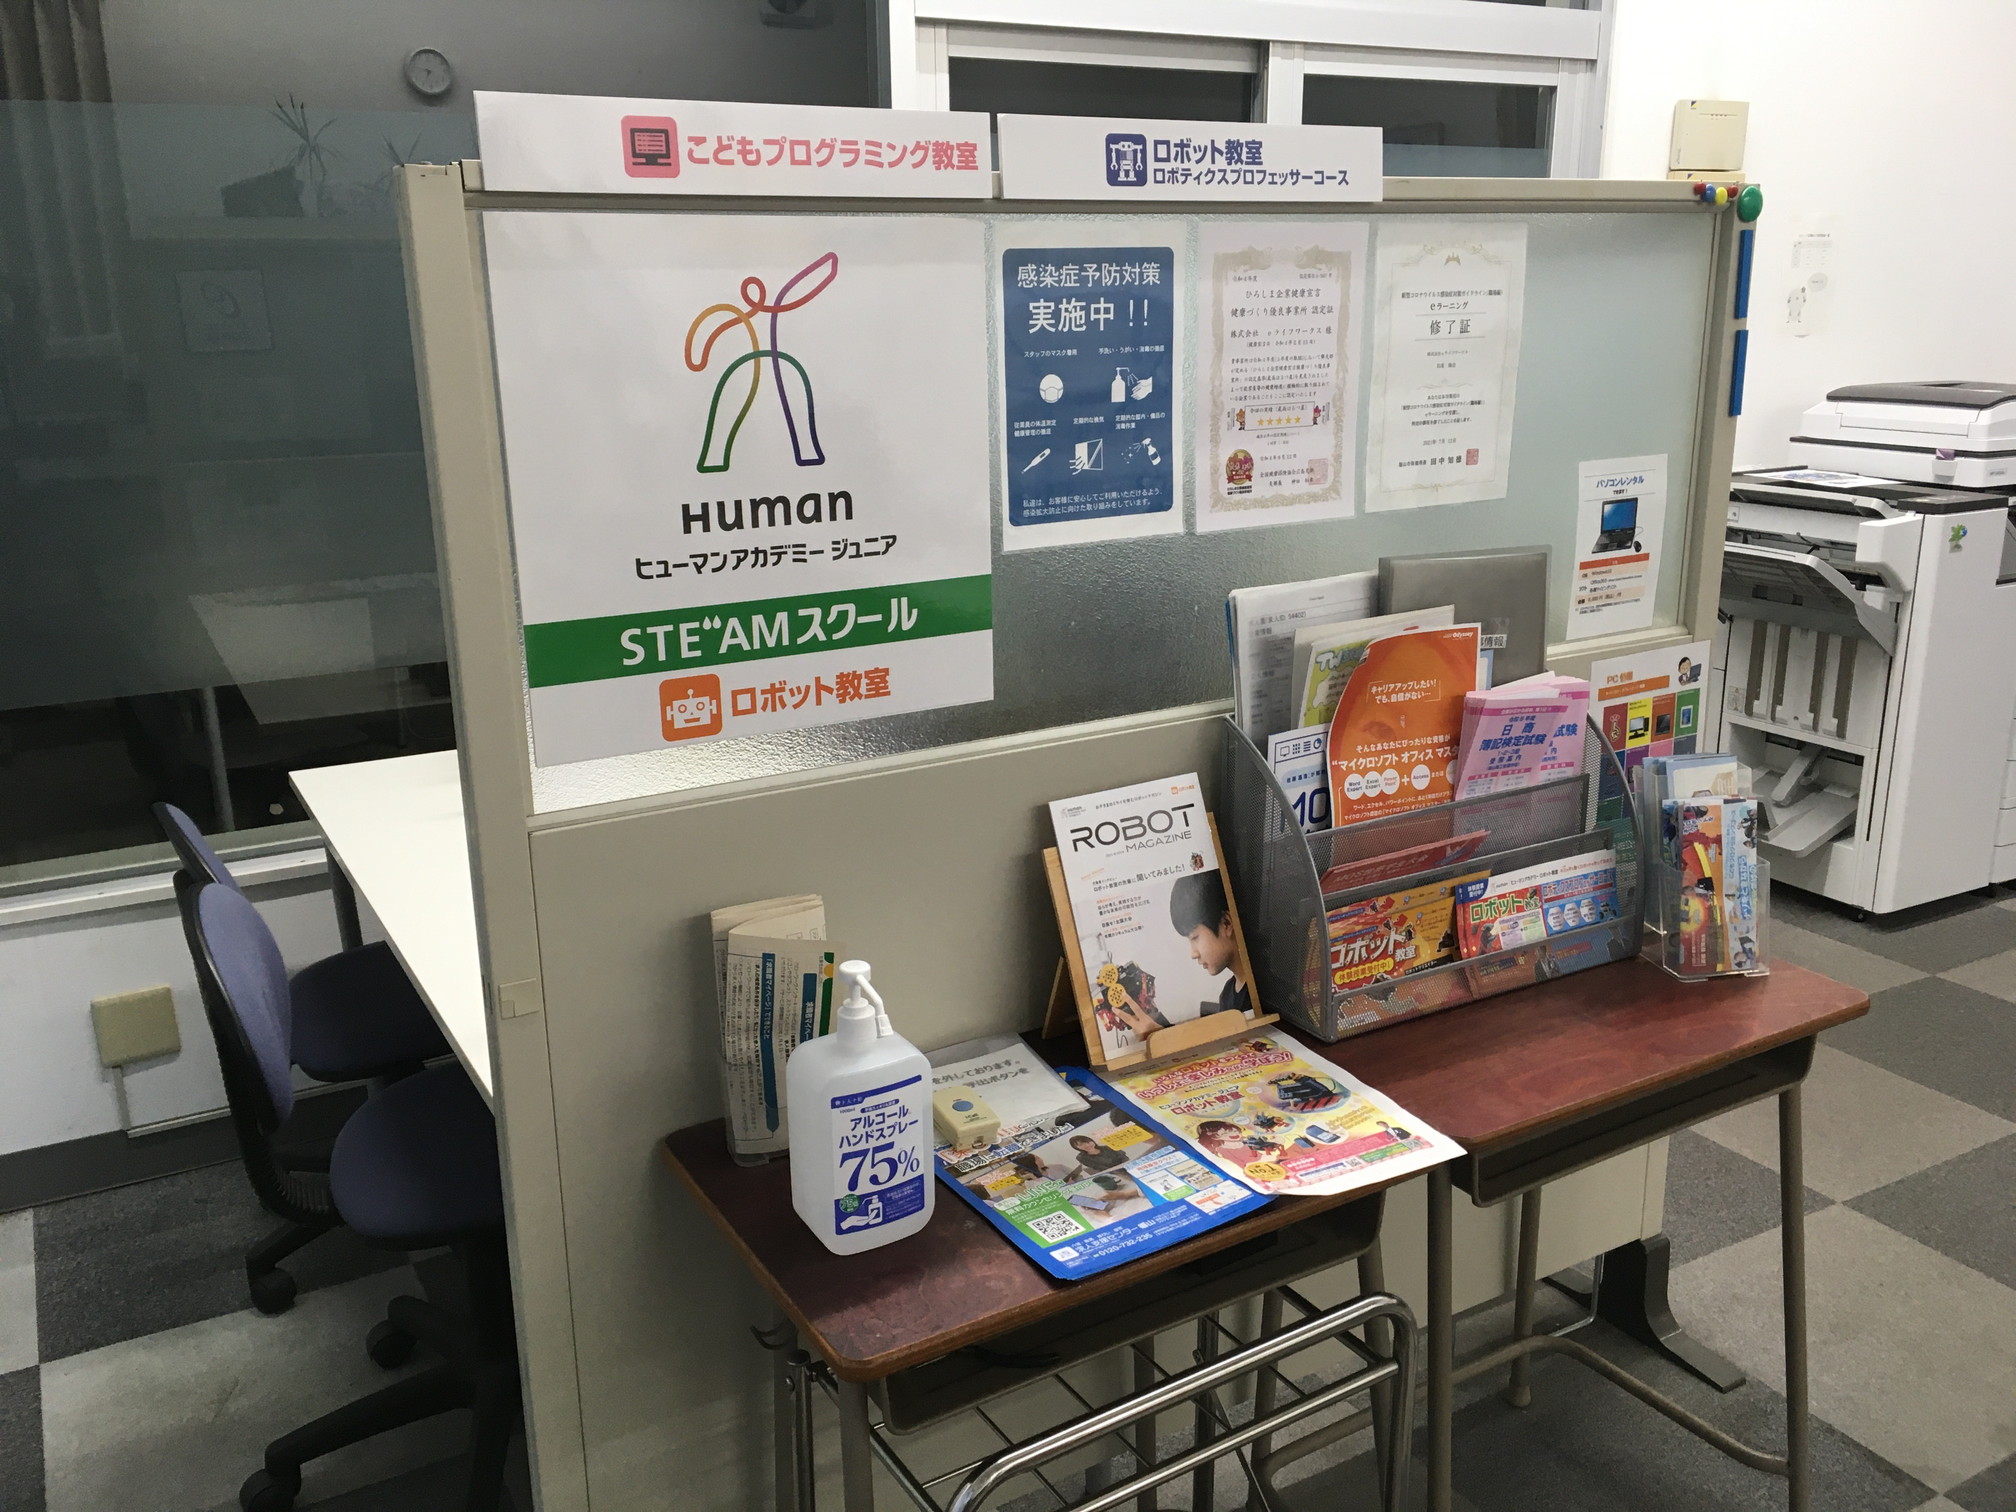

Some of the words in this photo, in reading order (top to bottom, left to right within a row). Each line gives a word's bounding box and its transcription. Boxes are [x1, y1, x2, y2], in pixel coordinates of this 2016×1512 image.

[687, 134, 979, 172] こどもプログラミング教室
[1153, 138, 1263, 166] ロボット教室
[1153, 168, 1350, 187] ロボティクスプロフェッサーコース
[1017, 262, 1161, 288] 感染症予防対策
[1245, 288, 1321, 299] ひろしま企業健康宣言
[1231, 306, 1308, 318] 健康づくり優良事業所
[1311, 305, 1334, 315] 認定証
[1430, 301, 1469, 311] eラーニング
[1430, 318, 1471, 336] 修了証
[1024, 349, 1078, 358] スタッフのマスク着用
[1596, 475, 1645, 488] パソコンレンタル
[682, 490, 853, 534] Human
[635, 543, 824, 580] ヒューマンアカデミー
[831, 534, 898, 561] ジュニア
[731, 667, 891, 717] ロボット教室
[1371, 679, 1437, 694] キャリアアップしたい!
[1553, 723, 1578, 738] 試験
[1479, 734, 1547, 751] 簿記検定試験
[1401, 747, 1433, 763] オフィス
[1070, 803, 1195, 852] ROBOT
[1125, 830, 1192, 853] MAGAZINE
[1470, 892, 1523, 923] ロボット
[1395, 945, 1417, 962] 教室
[1171, 1090, 1245, 1115] ロボット教室
[850, 1105, 909, 1131] アルコール
[839, 1119, 919, 1149] ハンドスプレー
[839, 1141, 920, 1192] 75%
